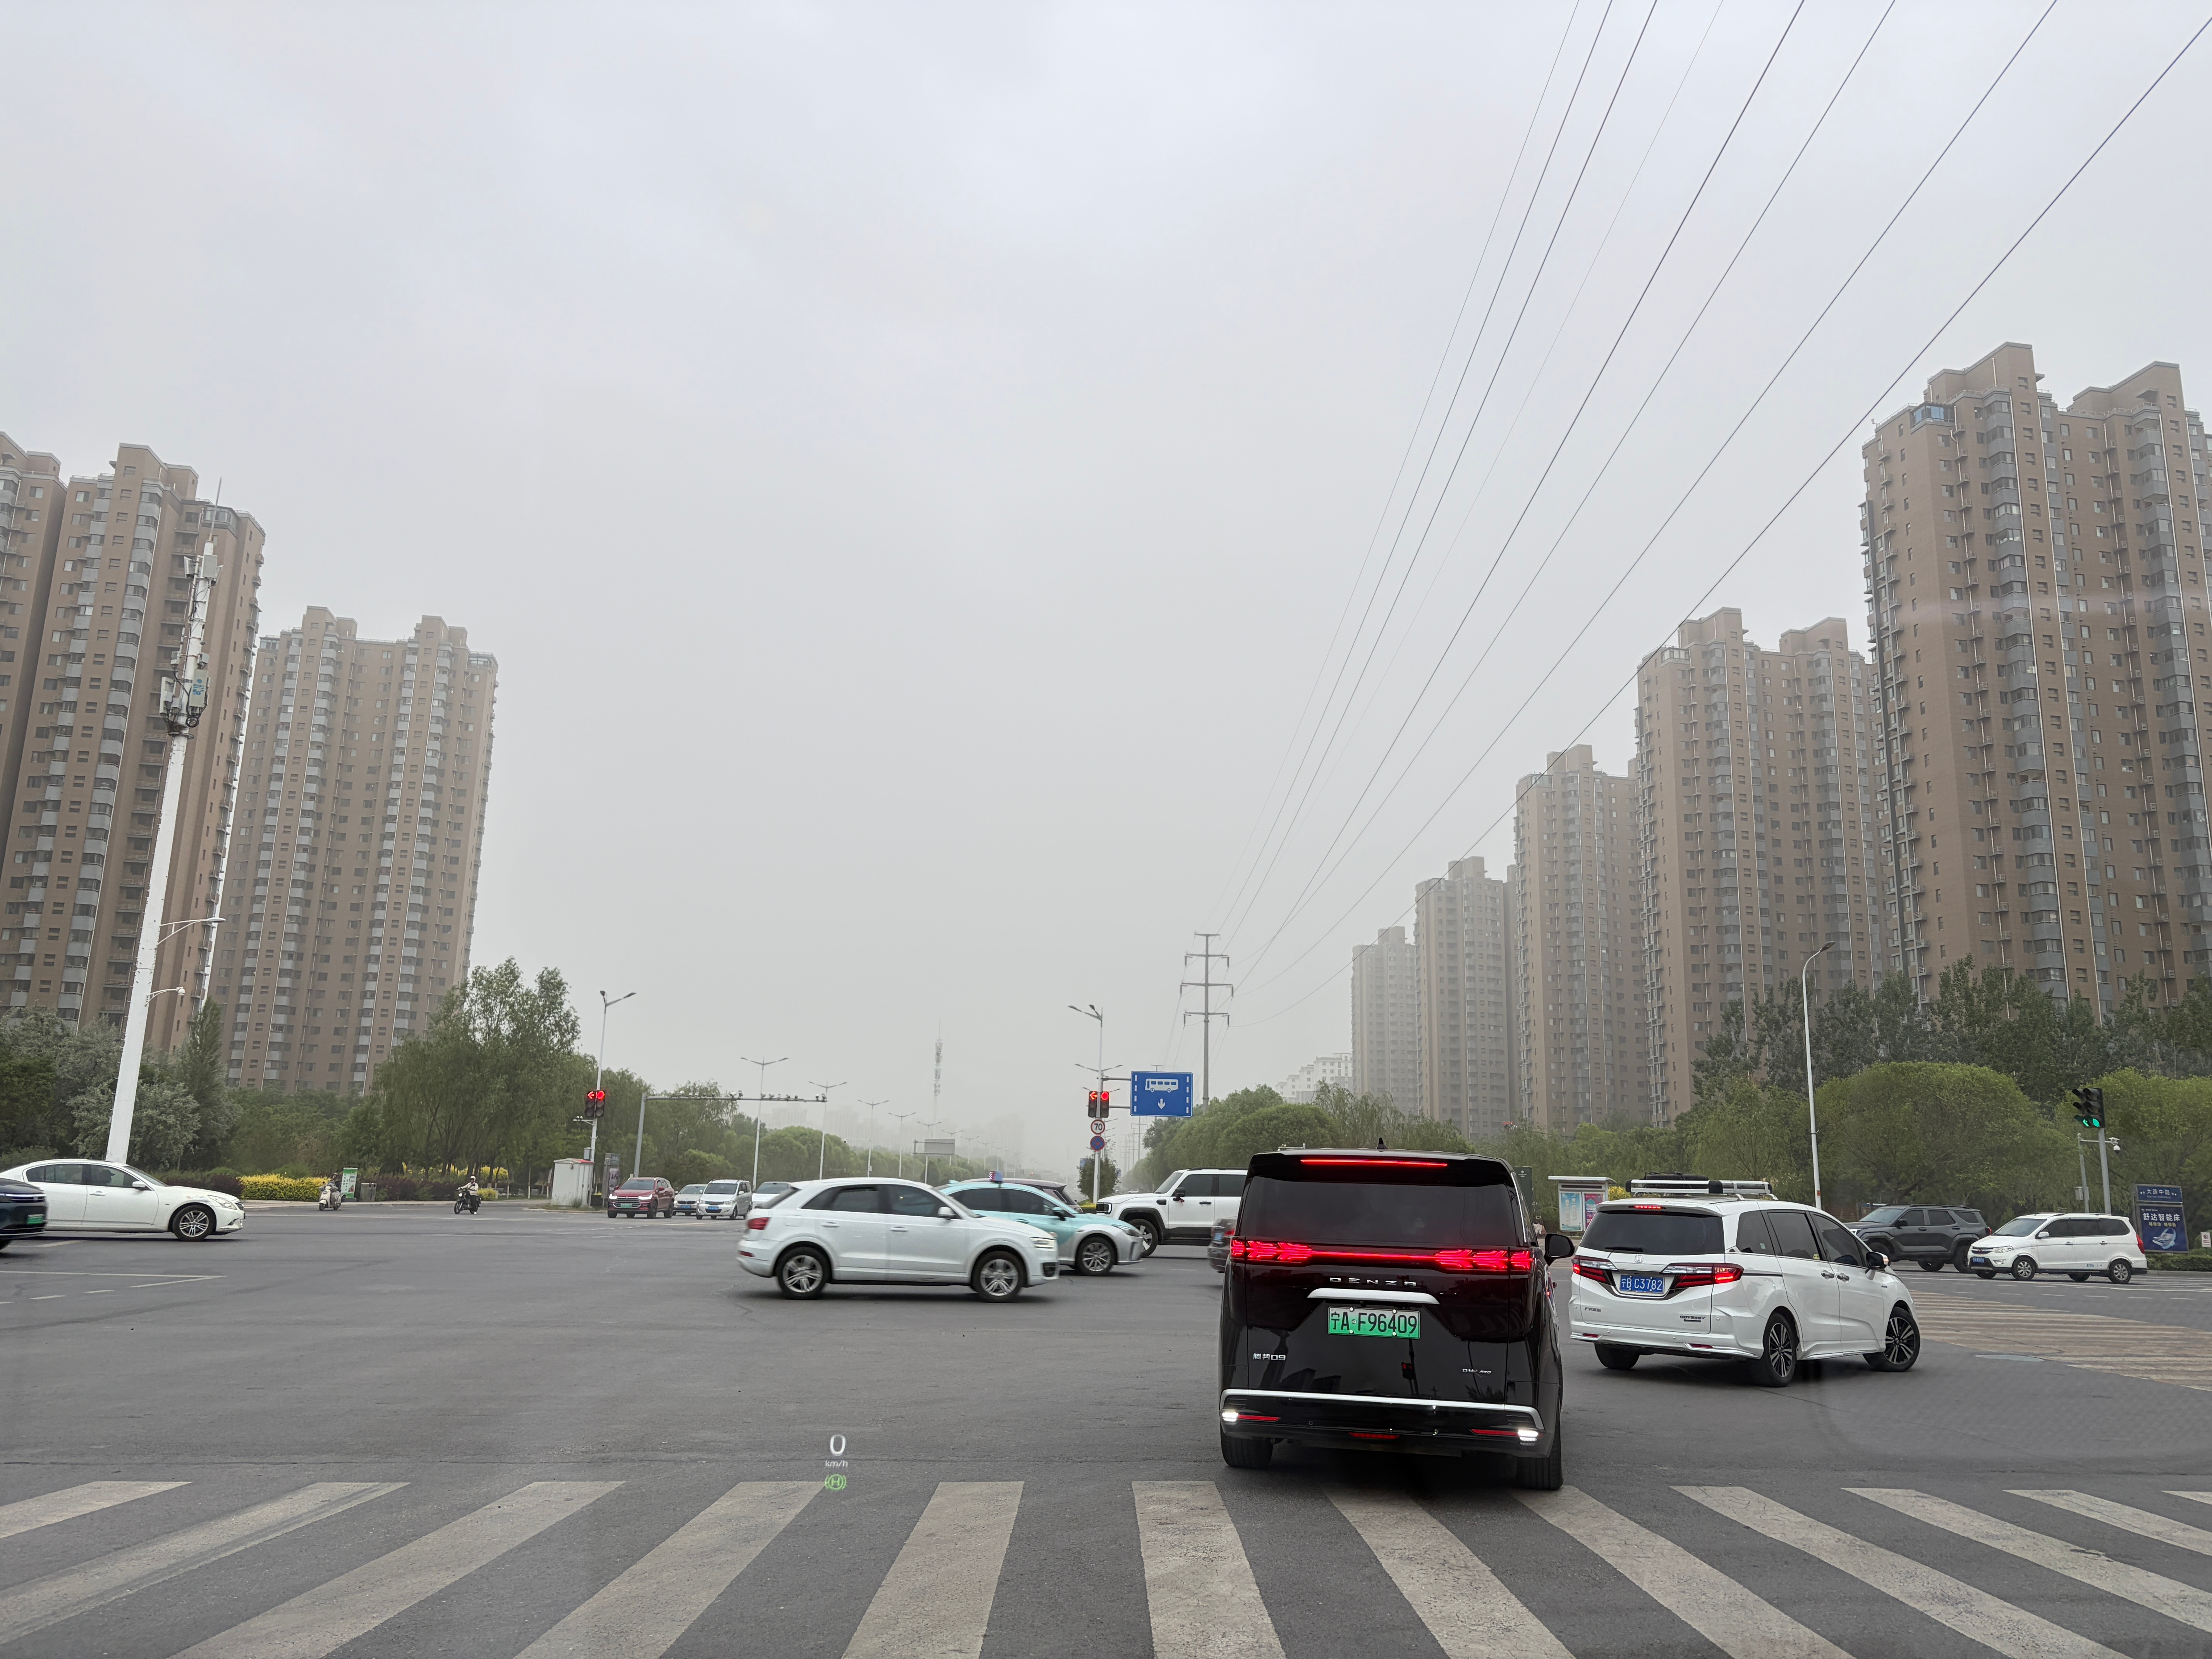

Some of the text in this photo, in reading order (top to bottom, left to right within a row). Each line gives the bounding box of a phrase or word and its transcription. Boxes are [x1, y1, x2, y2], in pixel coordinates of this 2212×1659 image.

[2143, 1213, 2180, 1221] 舒达智能床
[1329, 1277, 1417, 1286] DENZA
[830, 1434, 846, 1456] 0
